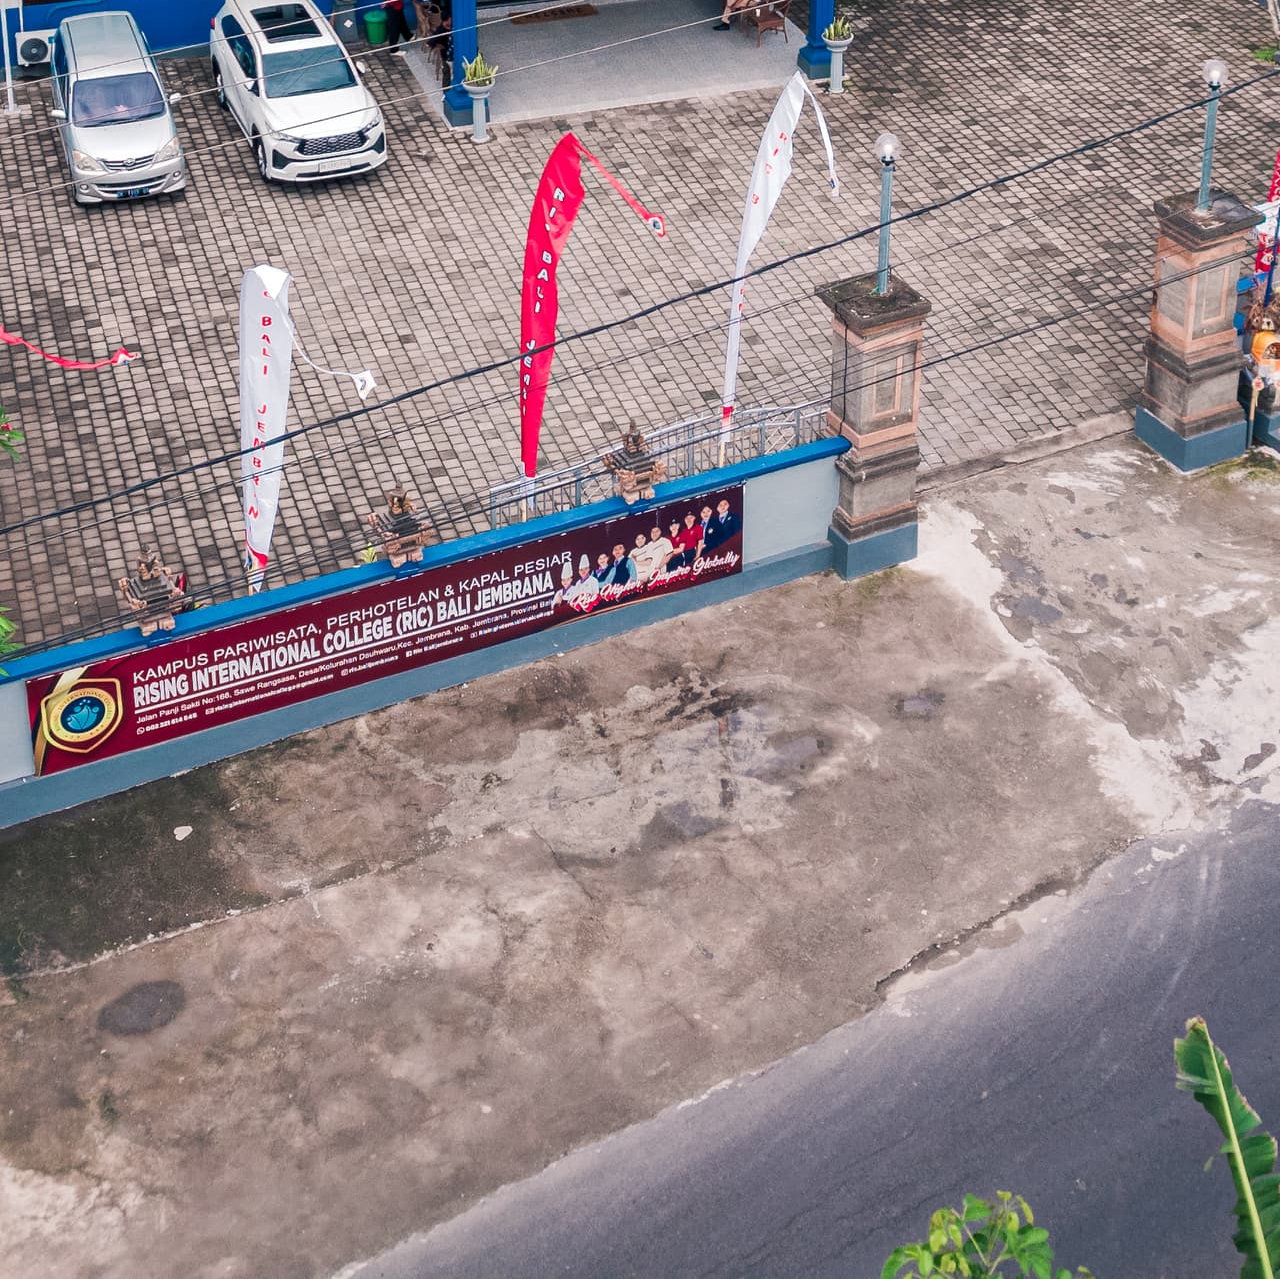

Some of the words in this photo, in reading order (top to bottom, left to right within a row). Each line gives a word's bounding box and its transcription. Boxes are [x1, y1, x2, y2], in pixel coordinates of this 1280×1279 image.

[261, 315, 273, 376] BALI
[693, 550, 739, 575] Globally
[133, 653, 208, 684] KAMPUS
[214, 623, 322, 662] PARIWISATA,
[327, 588, 439, 630] PERHOTELAN
[444, 584, 455, 597] &
[459, 569, 510, 594] KAPAL
[514, 551, 572, 577] PESIAR
[133, 673, 188, 708] RISING
[192, 637, 320, 691] INTERNATIONAL
[323, 616, 393, 653] COLLEGE
[396, 605, 433, 635] (RIC)
[437, 594, 470, 623] BALI
[474, 571, 553, 611] JEMBRANA
[136, 713, 158, 724] Jalan
[159, 707, 179, 719] Panji
